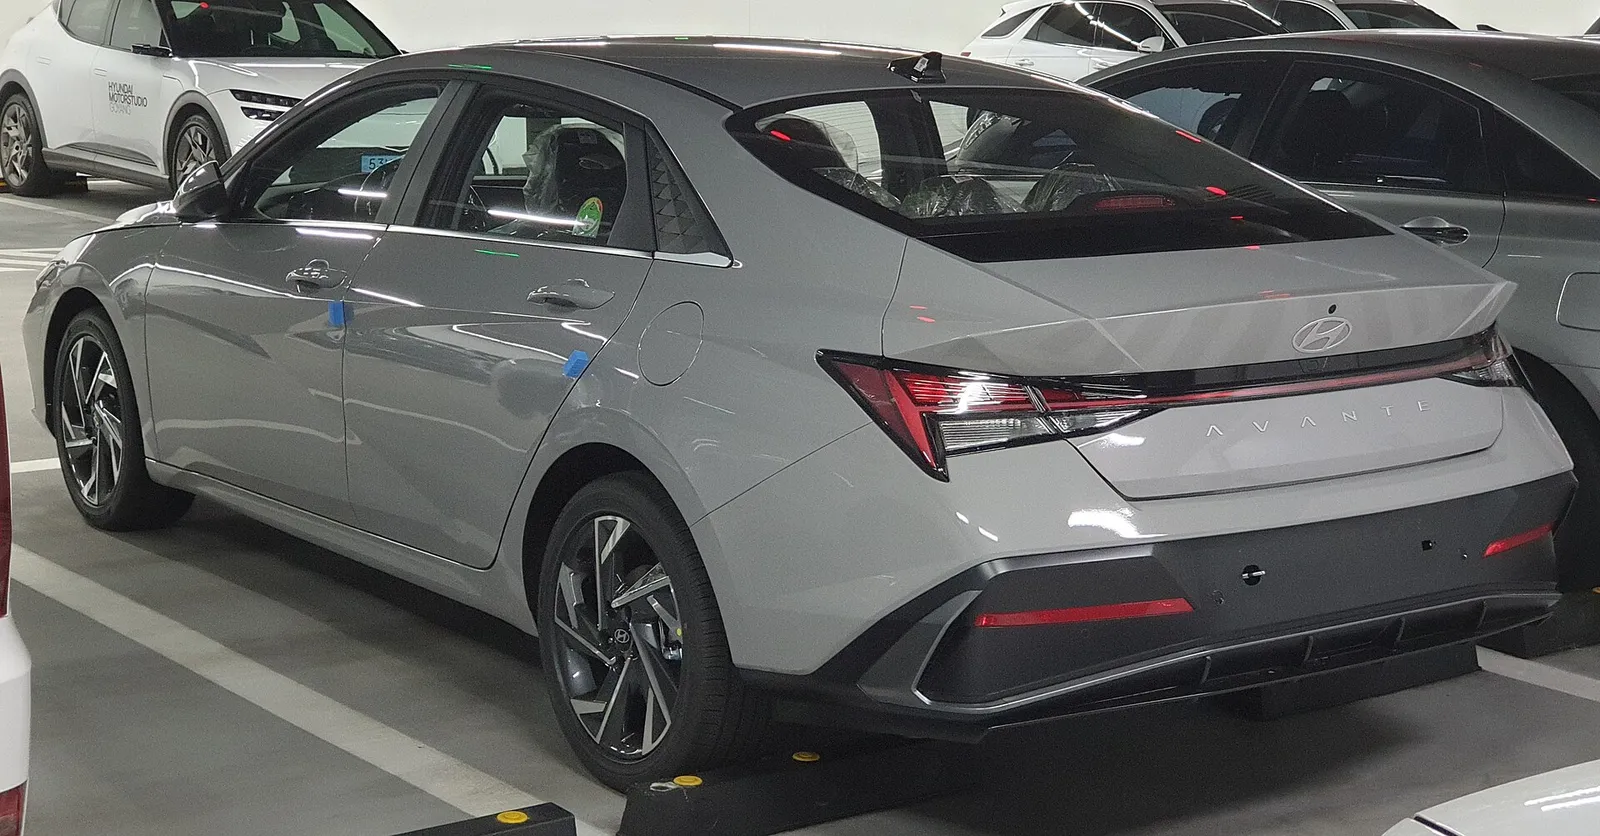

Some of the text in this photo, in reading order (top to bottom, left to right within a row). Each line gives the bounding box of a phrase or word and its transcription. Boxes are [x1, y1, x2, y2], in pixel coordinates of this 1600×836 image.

[108, 81, 133, 94] HYUNDAI
[108, 91, 148, 107] MOTORSTUDIO
[1206, 401, 1431, 437] AVANTE
